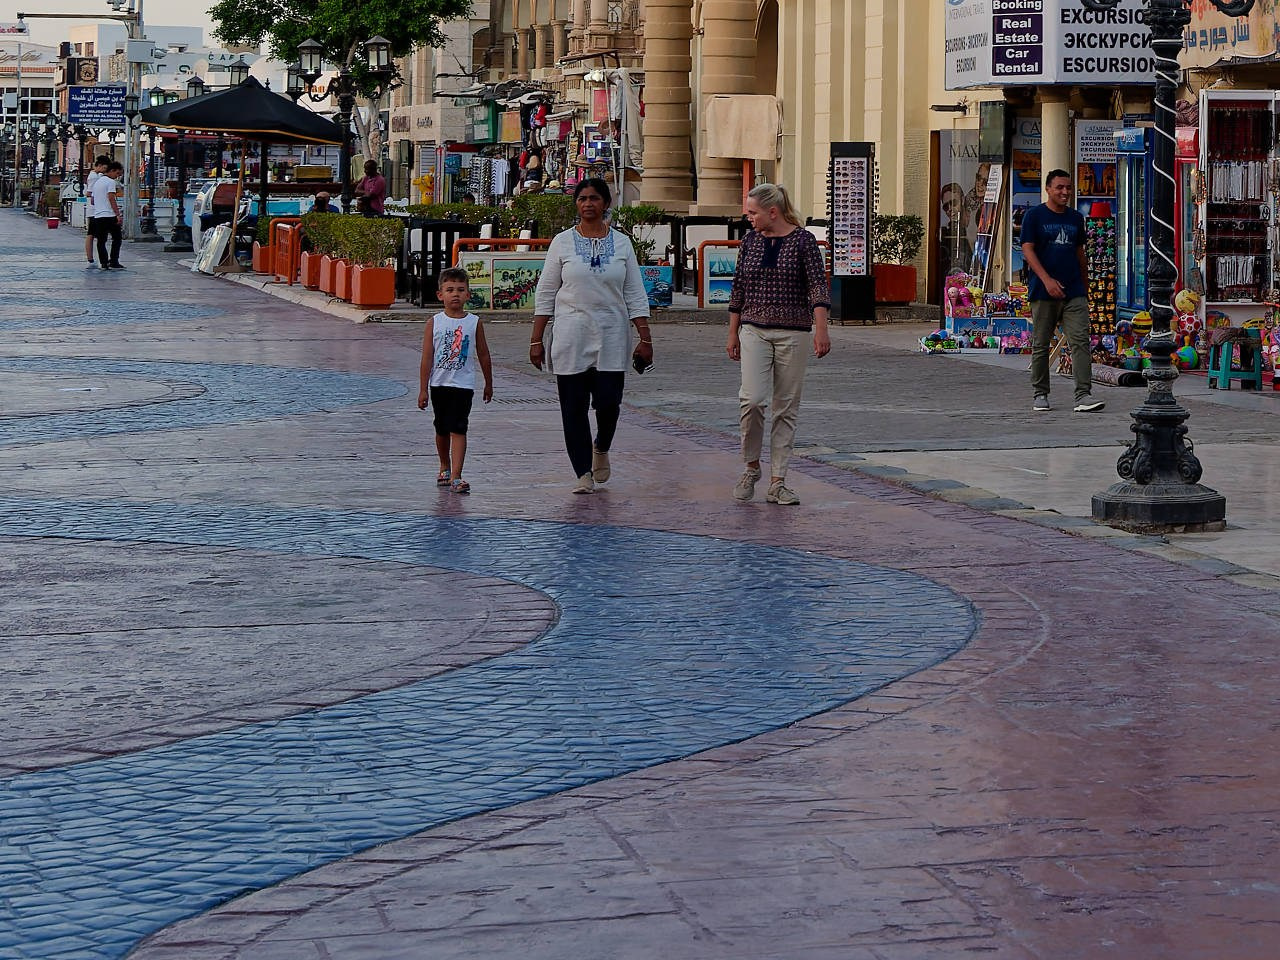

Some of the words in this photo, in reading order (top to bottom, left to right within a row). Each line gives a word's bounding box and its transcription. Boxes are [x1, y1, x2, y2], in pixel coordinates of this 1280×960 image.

[993, 0, 1042, 11] Booking
[1060, 8, 1144, 24] EXCURSIO
[1002, 18, 1032, 29] Real
[995, 33, 1039, 44] Estate
[1063, 32, 1153, 49] ЭКСКУРСИ
[1005, 48, 1029, 58] Car
[995, 62, 1039, 73] Rental
[1063, 57, 1156, 73] ESCURSION
[949, 145, 978, 158] MAX
